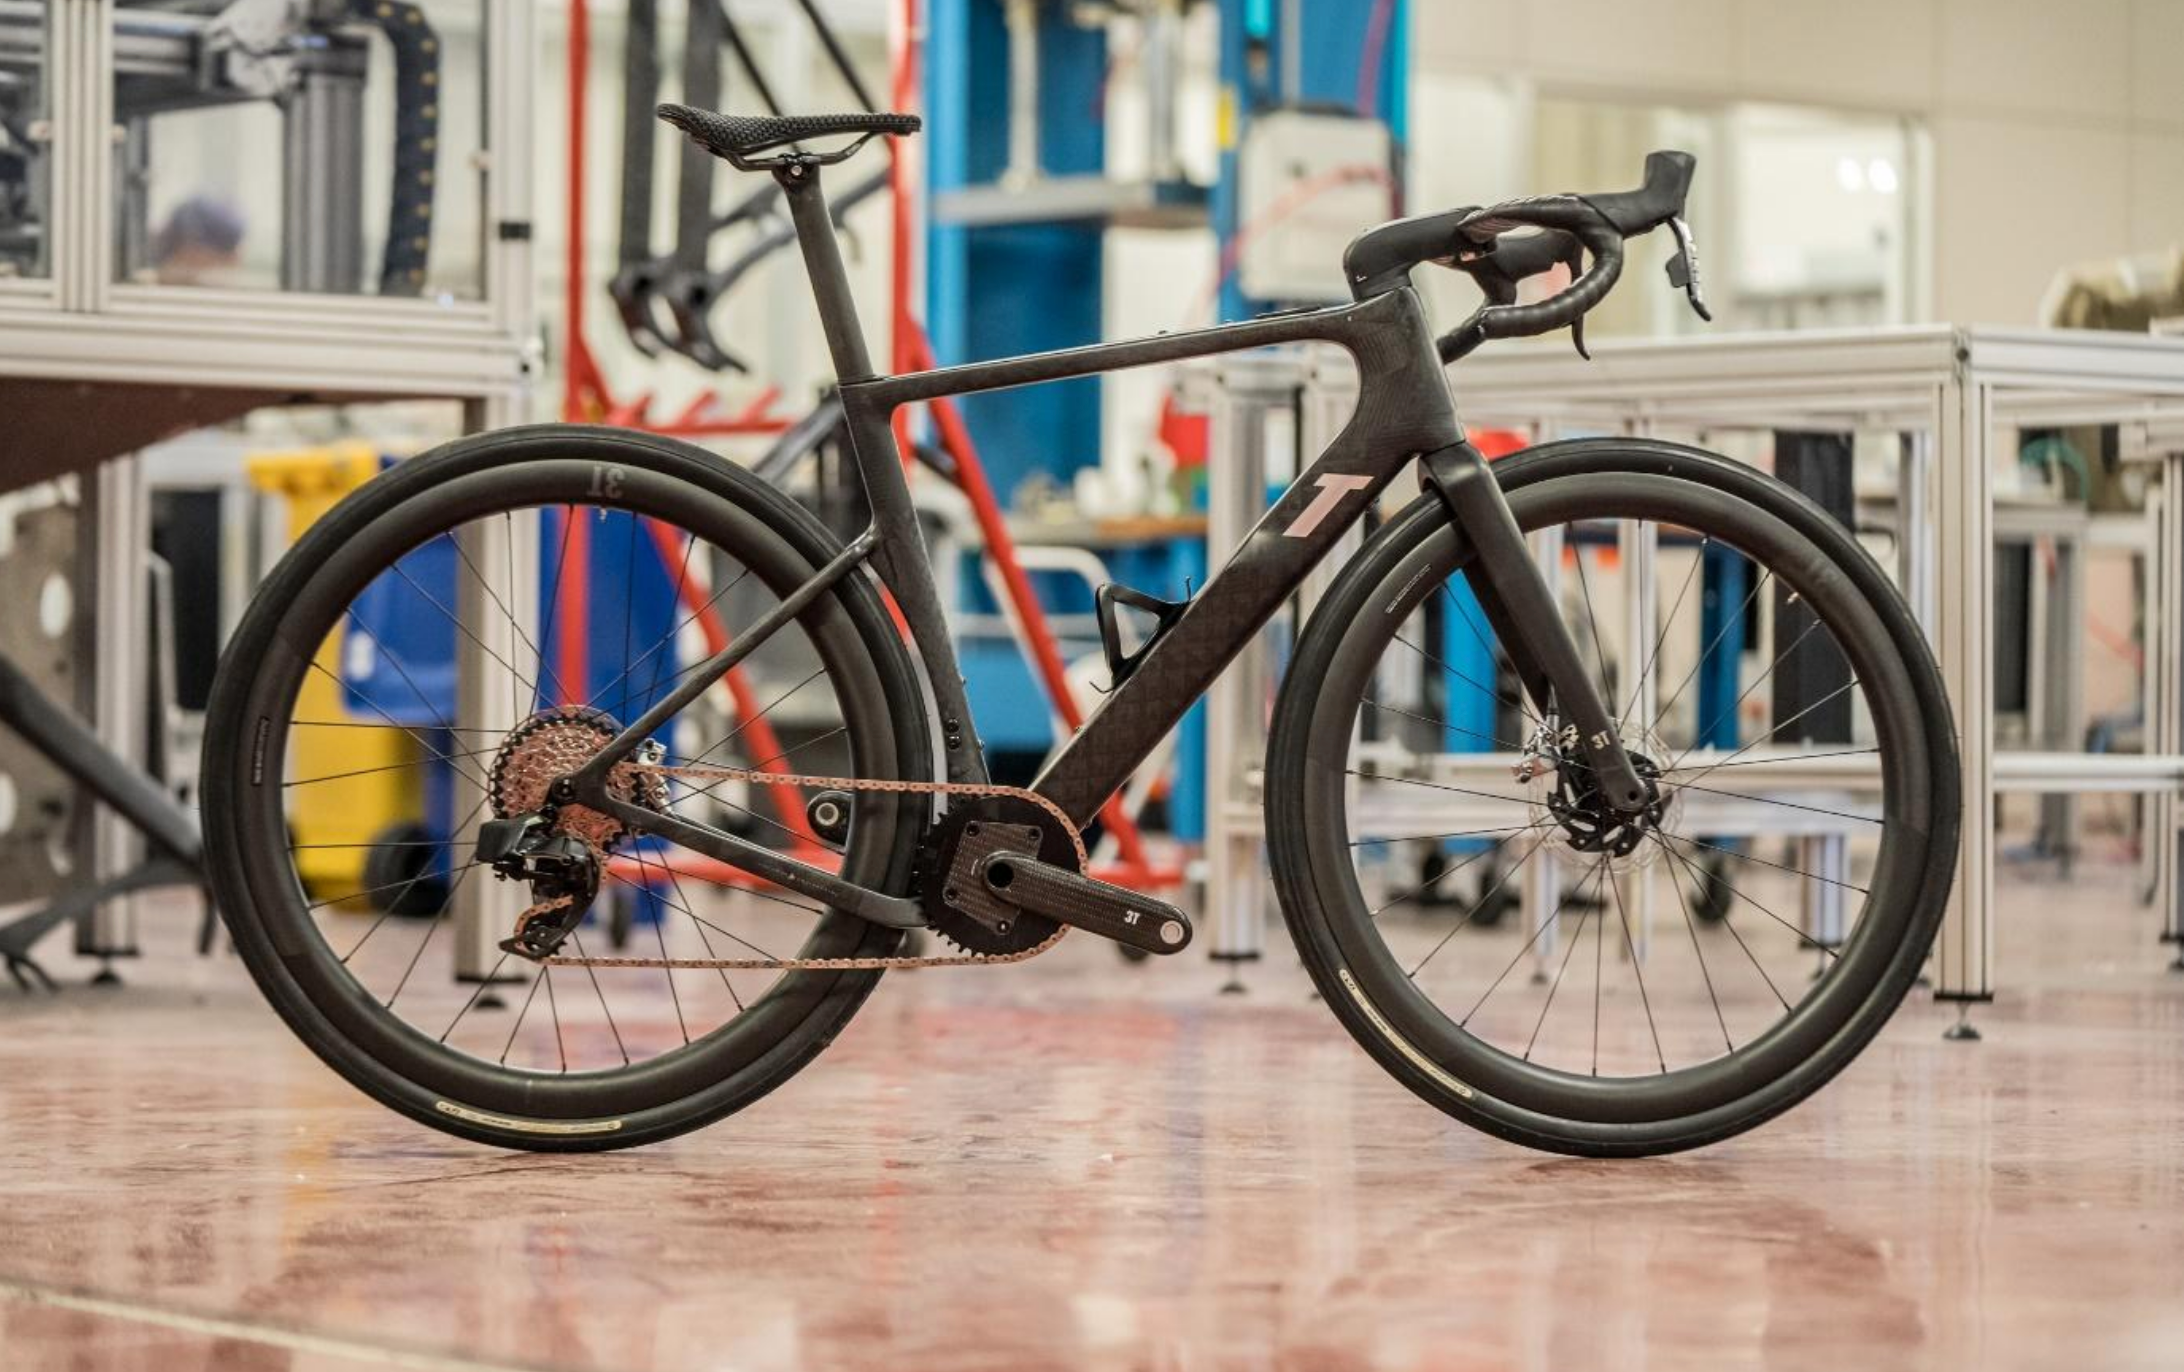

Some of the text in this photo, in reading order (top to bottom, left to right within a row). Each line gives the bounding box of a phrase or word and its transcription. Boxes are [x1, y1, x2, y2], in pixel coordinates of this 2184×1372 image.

[586, 465, 625, 499] 3T
[1591, 730, 1611, 750] 3T
[1124, 910, 1141, 925] 3T
